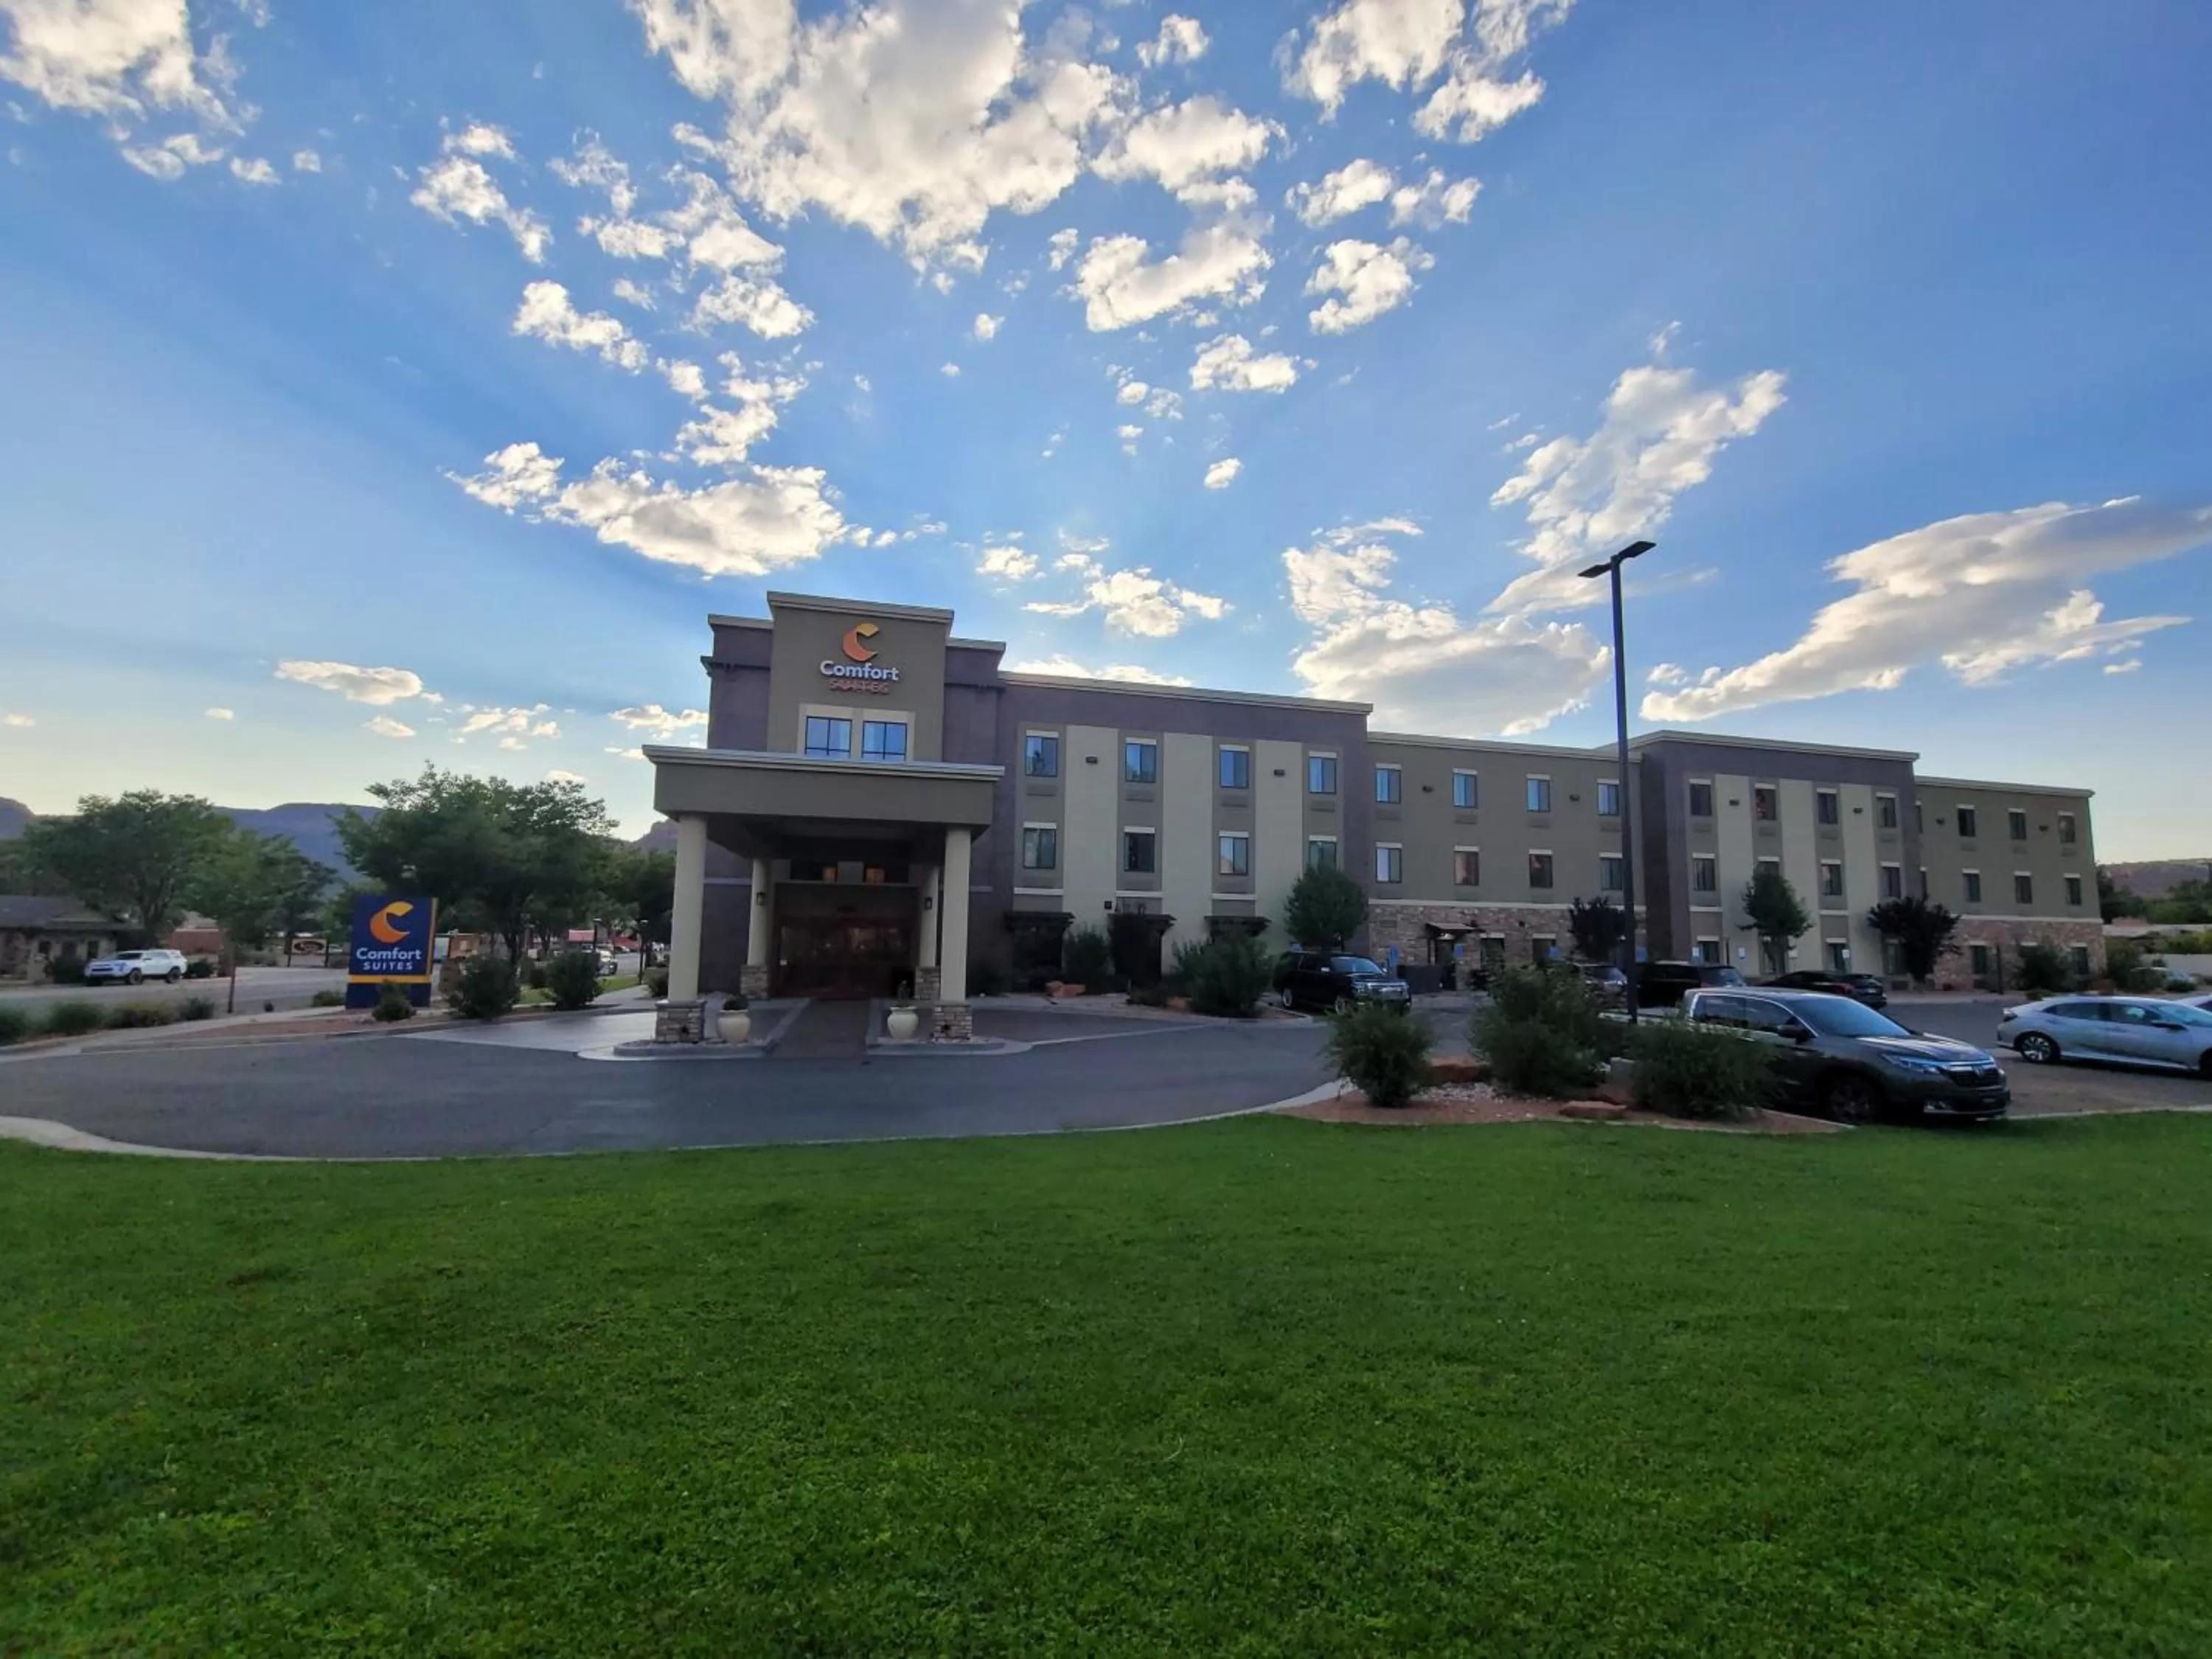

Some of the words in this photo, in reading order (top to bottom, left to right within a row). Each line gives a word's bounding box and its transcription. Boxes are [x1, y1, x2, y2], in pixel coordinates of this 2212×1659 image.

[820, 661, 900, 681] Comfort
[829, 678, 889, 694] SUITES
[356, 947, 422, 959] Comfort
[363, 961, 414, 970] SUITES
